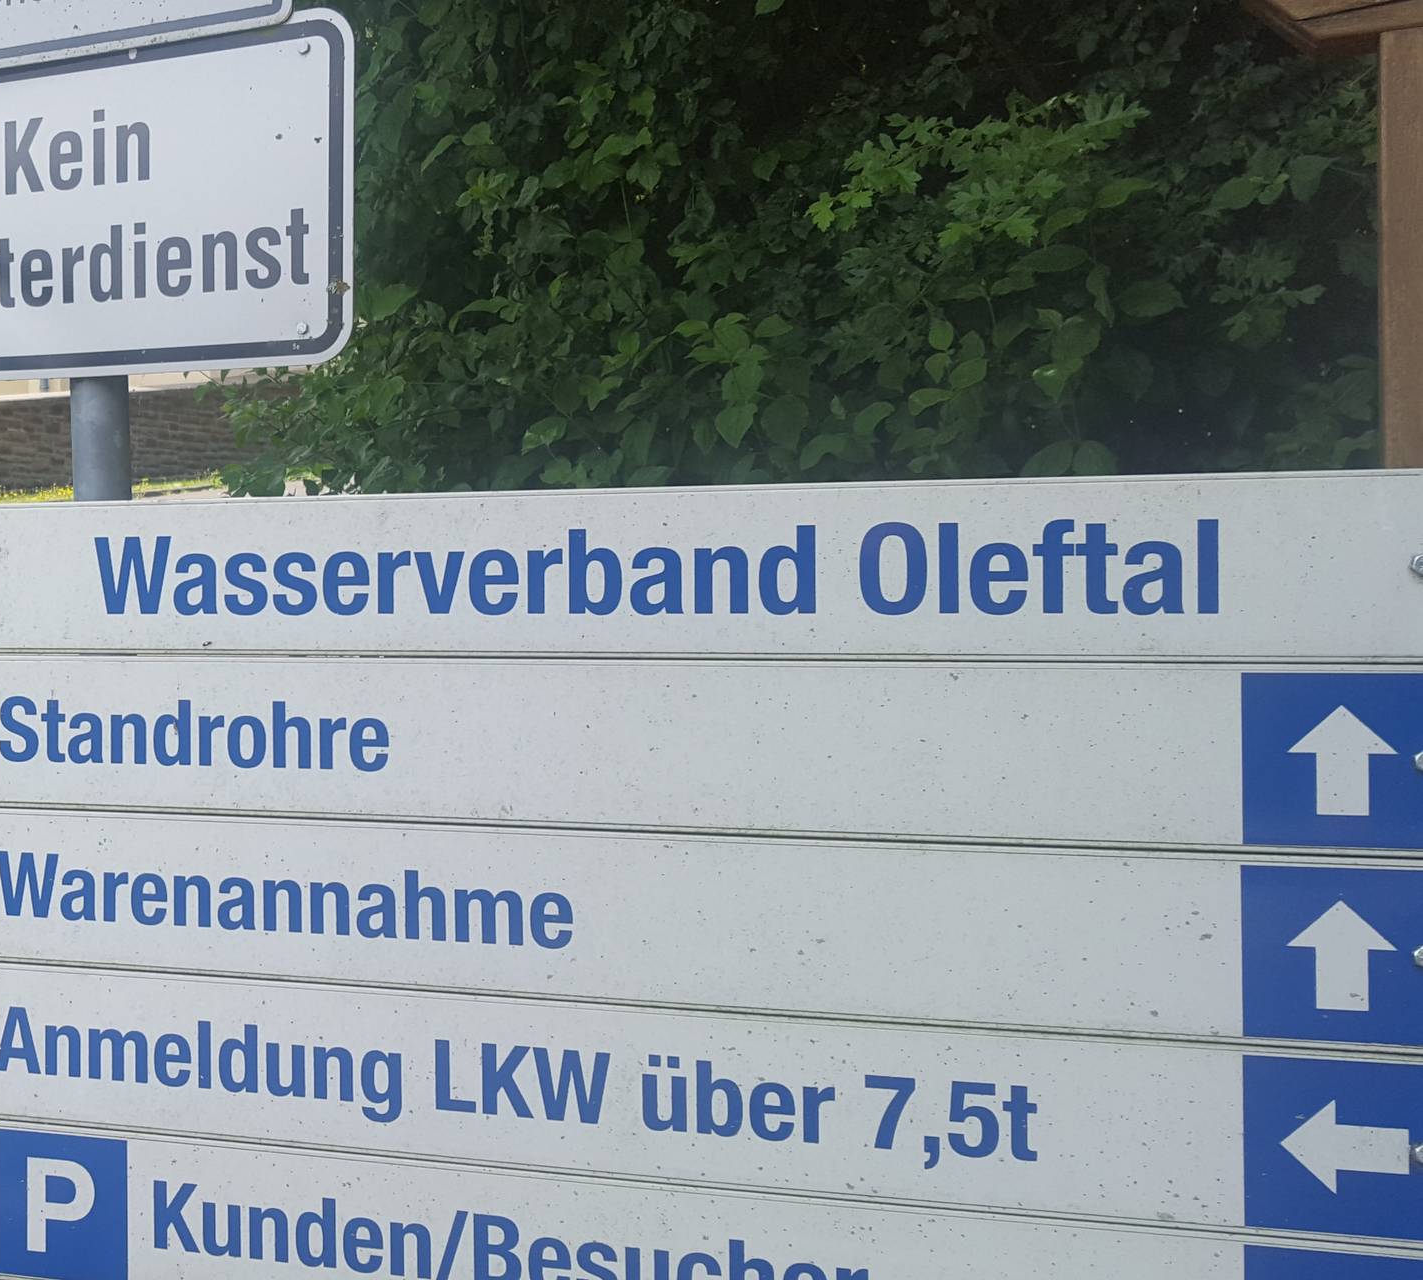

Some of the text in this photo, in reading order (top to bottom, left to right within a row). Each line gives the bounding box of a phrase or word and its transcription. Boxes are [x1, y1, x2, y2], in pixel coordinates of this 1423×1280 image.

[4, 109, 150, 196] Kein
[95, 519, 1220, 617] Wasserverband Oleftal
[435, 1039, 610, 1126] LKW
[642, 1055, 835, 1144] über
[864, 1075, 1039, 1169] 7,5t
[26, 1156, 869, 1280] P Kunden/Besuh
